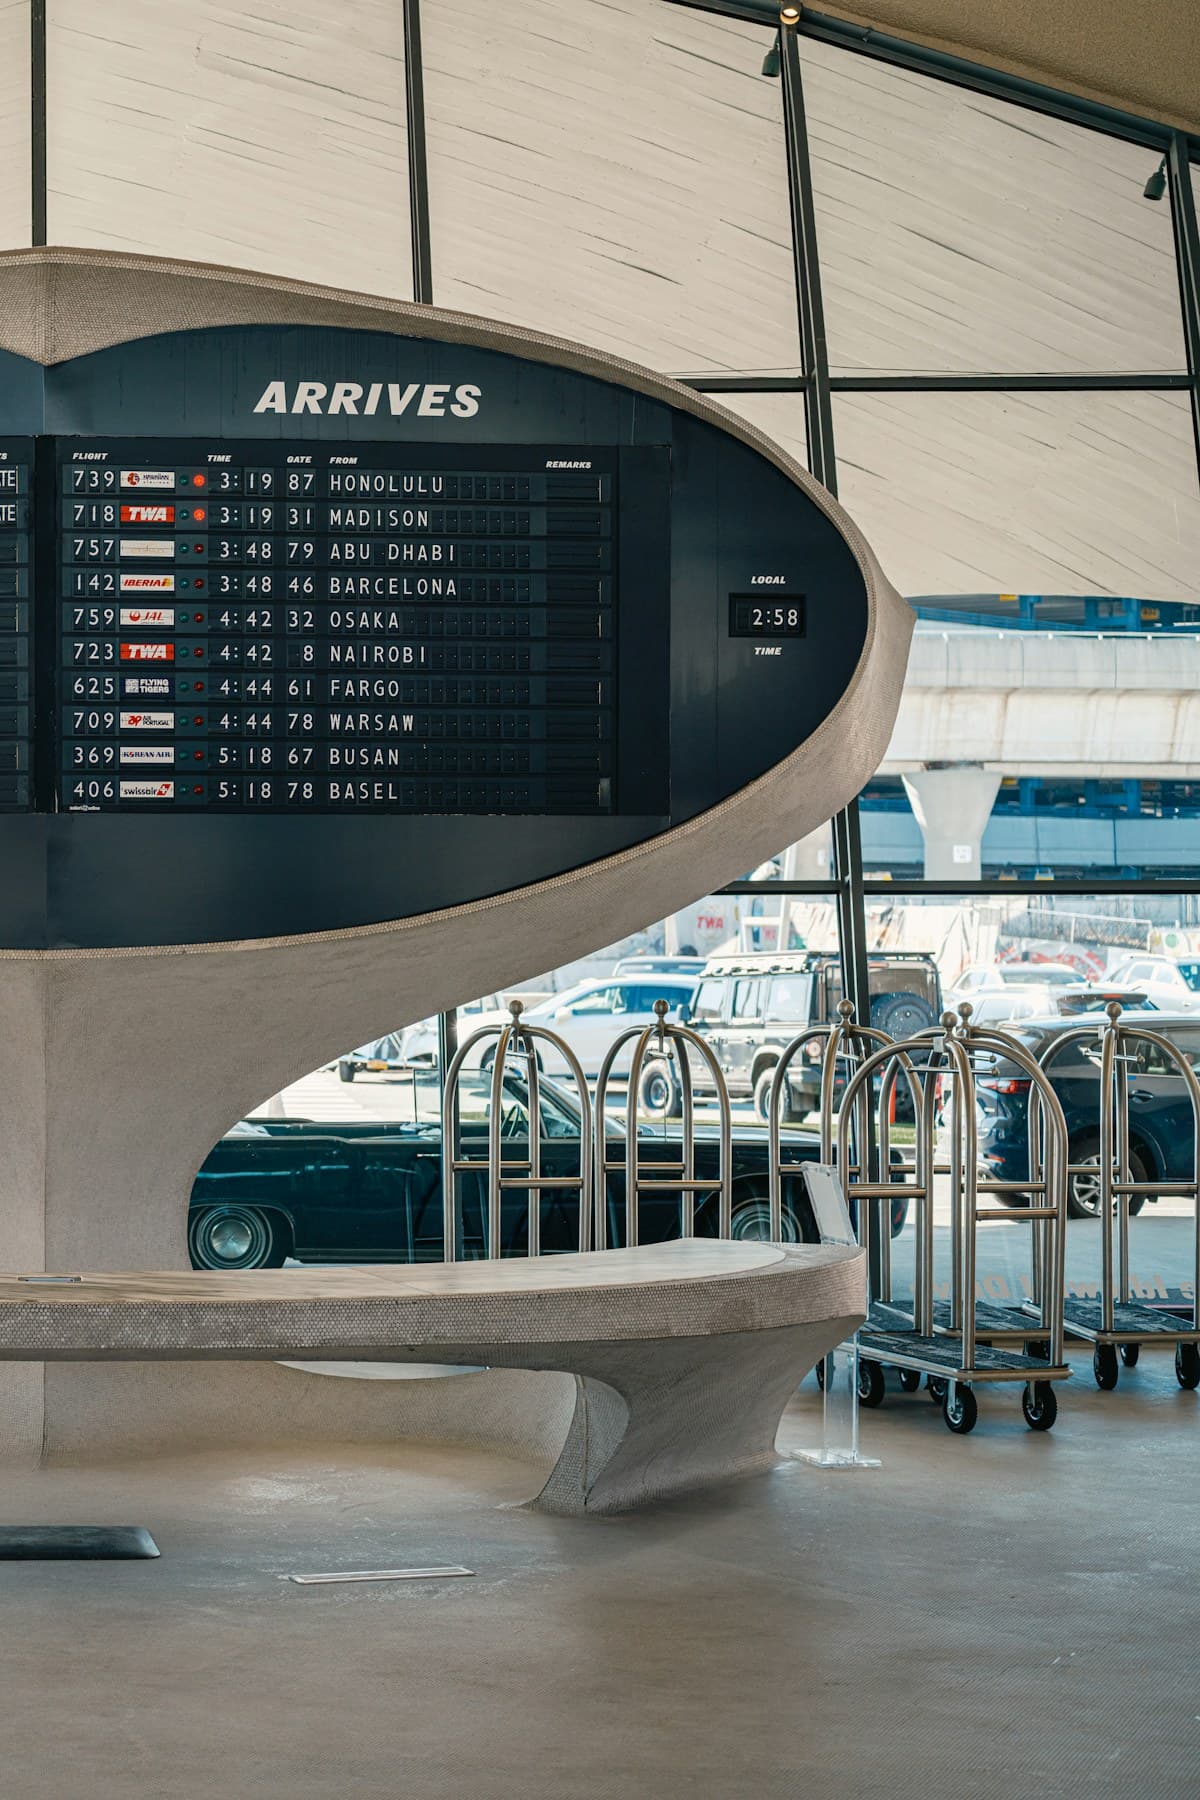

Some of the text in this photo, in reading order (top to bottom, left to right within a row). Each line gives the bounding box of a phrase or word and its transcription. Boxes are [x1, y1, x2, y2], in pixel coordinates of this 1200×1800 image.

[253, 381, 481, 417] ARRIVES
[74, 471, 442, 492] 739 3:19 87 HONOLULU
[74, 505, 427, 526] 718 3:19 31 MADISON
[129, 507, 166, 521] TWA
[74, 540, 453, 560] 757 3:48 79 ABU DHABI
[78, 575, 456, 595] 142 3:48 46 BARCELONA
[124, 579, 161, 587] IBERIA
[751, 576, 785, 584] LOCAL
[74, 609, 398, 628] 759 4:42 32 OSAKA
[143, 611, 162, 621] JAL
[753, 609, 797, 625] 2:58
[74, 643, 424, 662] 723 4:42 8 NAIROBI
[129, 645, 166, 658] TWA
[755, 647, 782, 655] TIME
[75, 678, 398, 696] 625 4:44 61 FARGO
[74, 712, 413, 731] 709 4:44 78 WARSAW
[75, 747, 398, 765] 369 5:18 67 BUSAN
[74, 781, 397, 799] 406 5:18 78 BASEL
[124, 786, 157, 795] swissair
[697, 917, 723, 928] TWA
